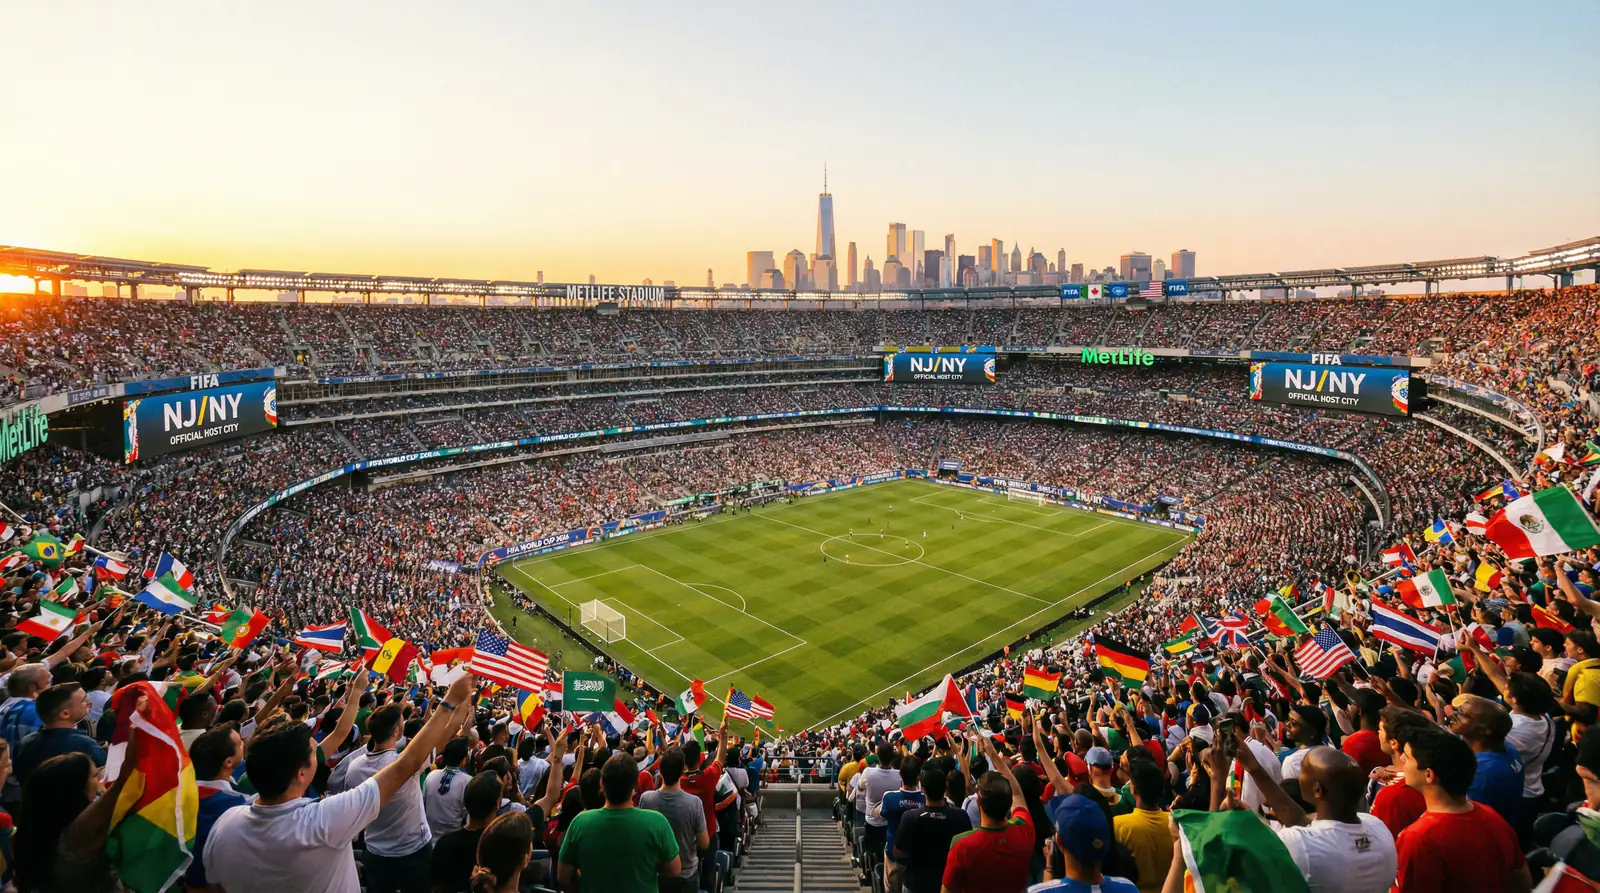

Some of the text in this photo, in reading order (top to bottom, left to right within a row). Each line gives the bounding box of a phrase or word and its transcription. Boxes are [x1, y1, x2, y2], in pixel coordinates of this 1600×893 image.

[566, 285, 665, 301] METLIFE STADIUM
[1168, 284, 1186, 292] FIFA
[910, 356, 967, 373] NJ/NY
[1081, 347, 1154, 366] MetLife
[1311, 354, 1342, 366] FIFA
[190, 373, 220, 390] FIFA
[1284, 368, 1366, 395] NJ/NY
[1288, 391, 1360, 406] OFFICIAL HOST CITY
[163, 392, 243, 432] NJ/NY
[0, 403, 49, 465] MetLife
[170, 423, 240, 445] OFFICIAL HOST CITY
